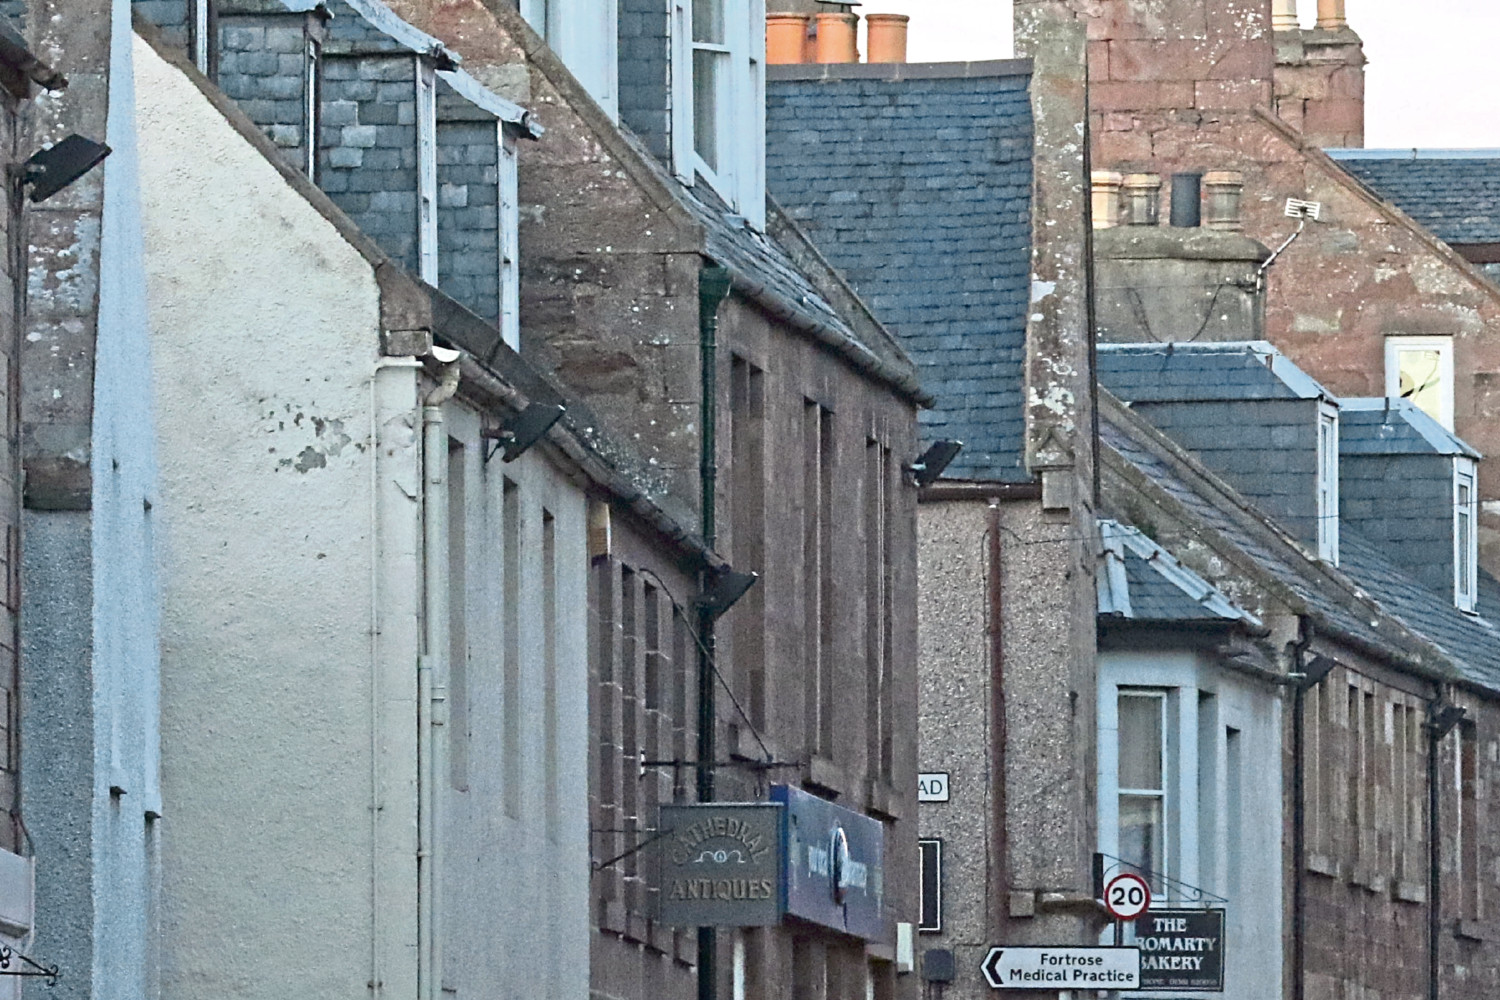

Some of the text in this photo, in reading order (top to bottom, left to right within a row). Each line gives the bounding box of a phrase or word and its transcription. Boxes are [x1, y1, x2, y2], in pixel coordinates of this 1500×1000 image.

[670, 879, 772, 901] ANTIQUES
[1111, 886, 1144, 906] 20
[1153, 917, 1188, 932] THE
[1136, 936, 1217, 952] ROMARTY
[1040, 953, 1103, 967] Fortrose
[1009, 968, 1067, 982] Medical
[1073, 968, 1134, 982] Practice
